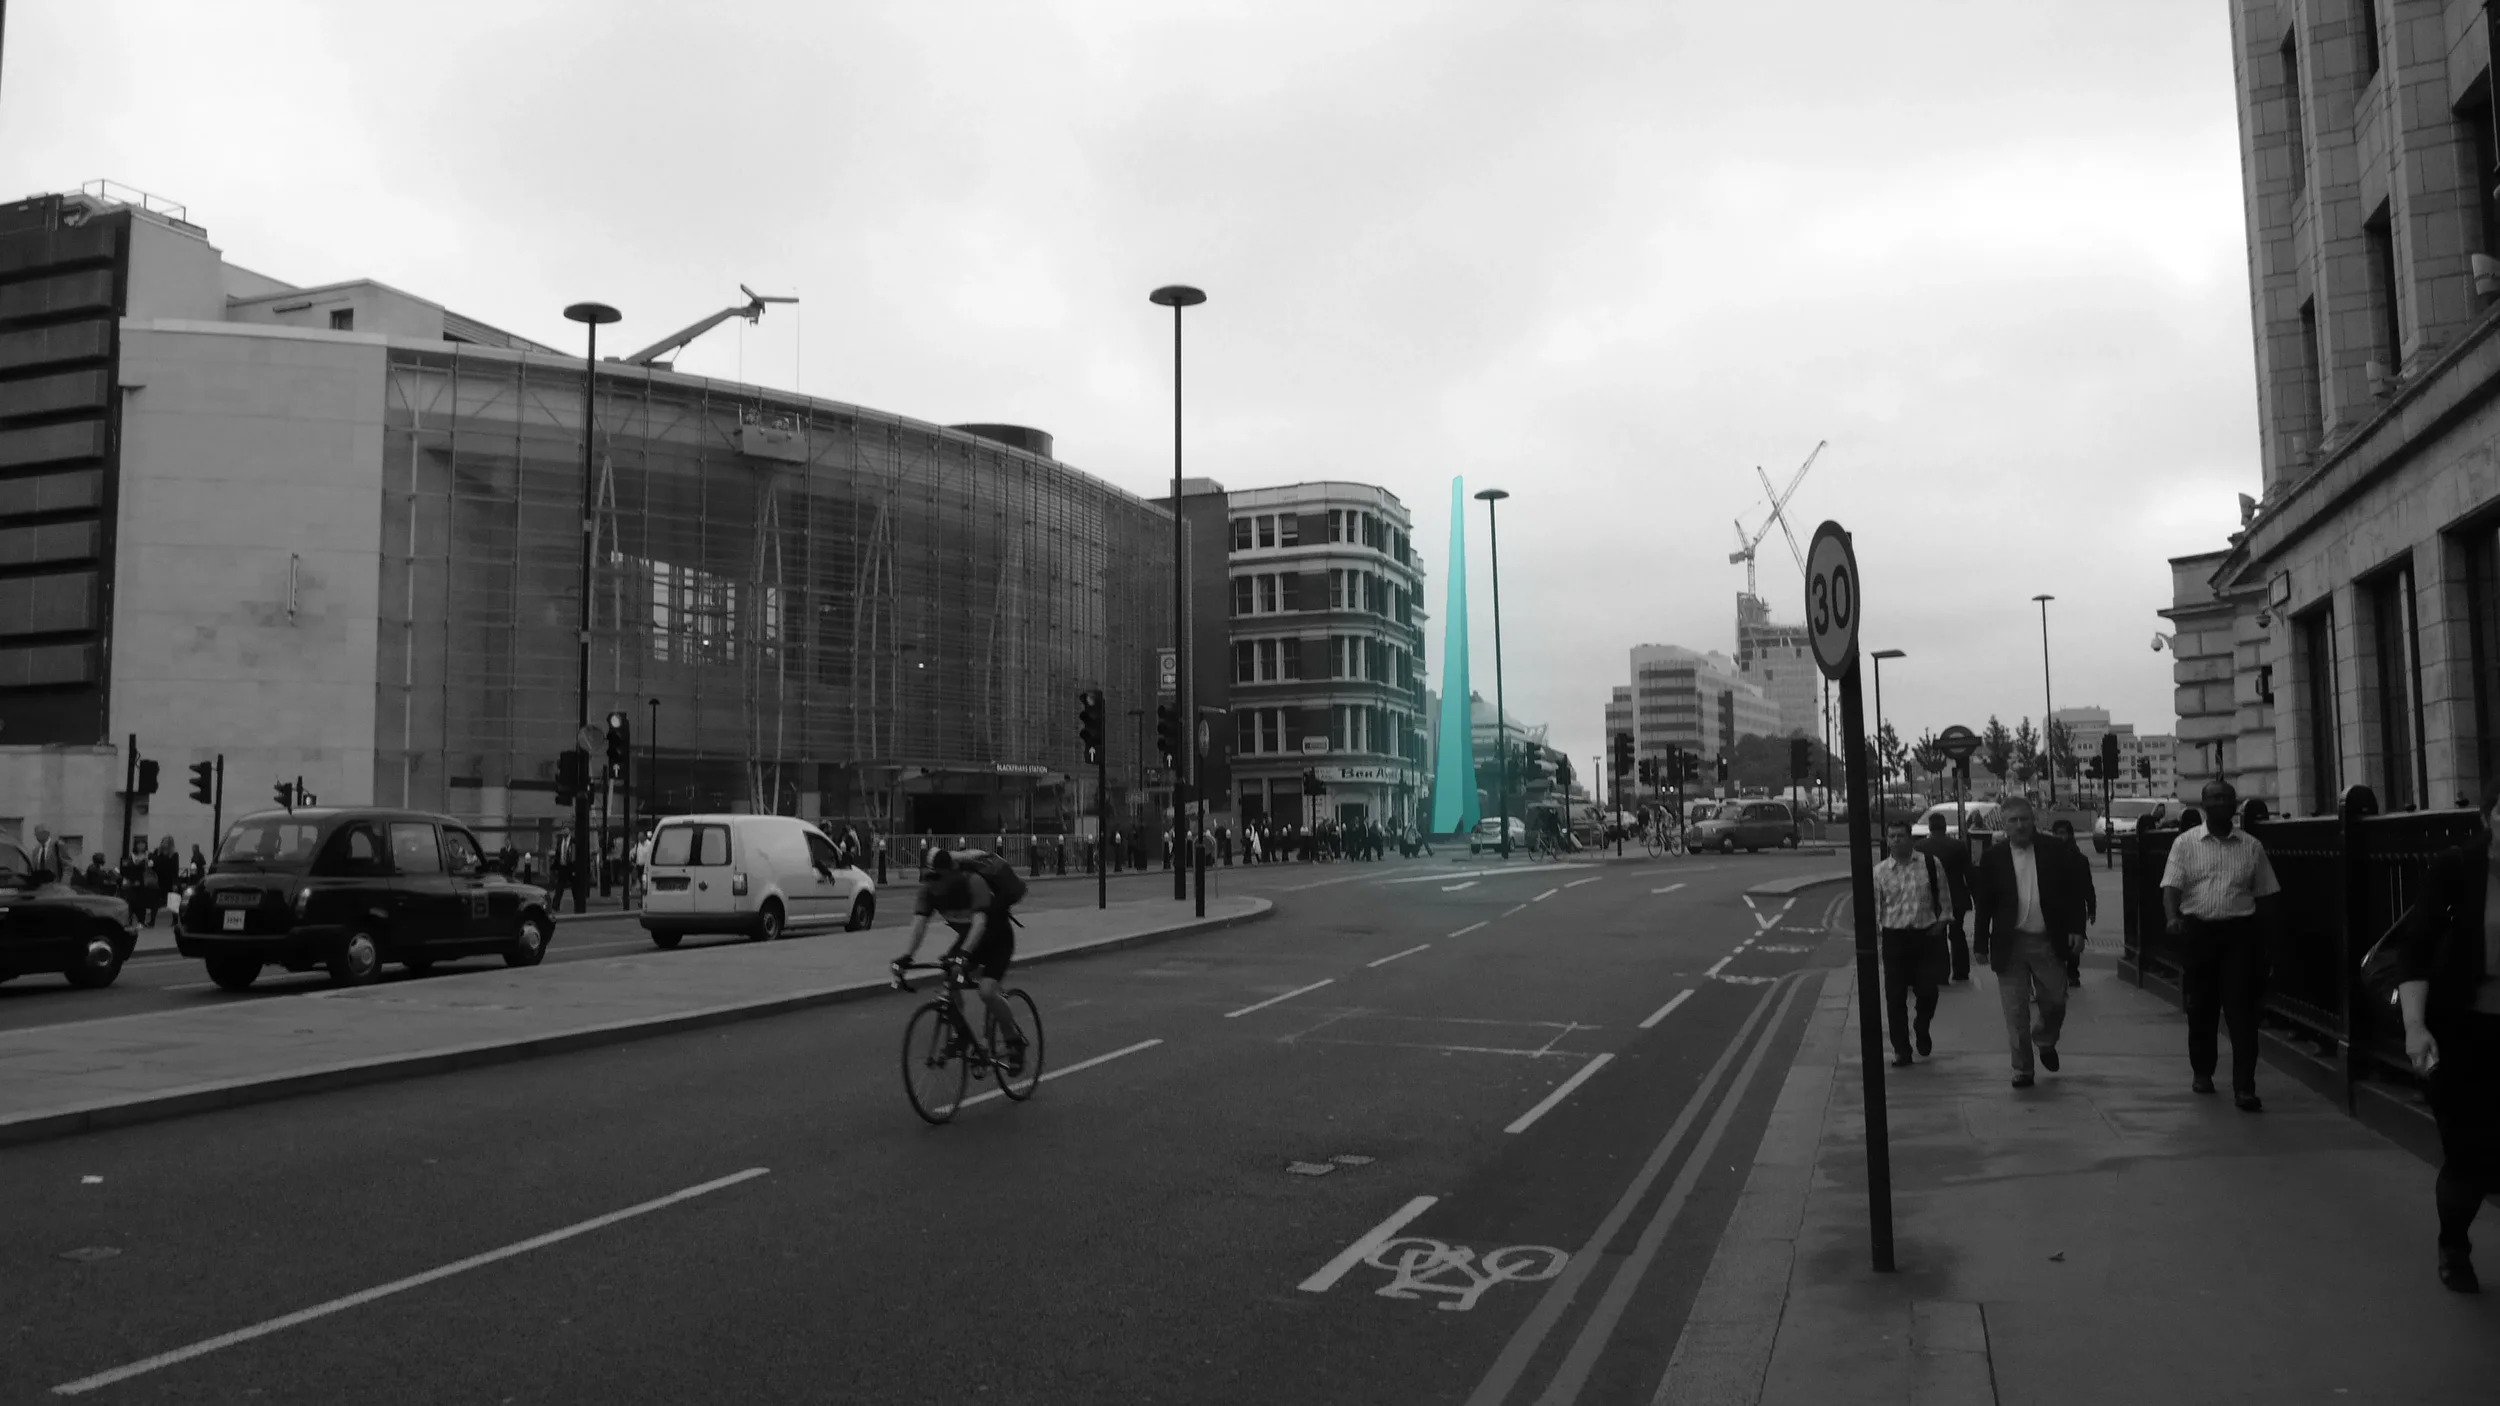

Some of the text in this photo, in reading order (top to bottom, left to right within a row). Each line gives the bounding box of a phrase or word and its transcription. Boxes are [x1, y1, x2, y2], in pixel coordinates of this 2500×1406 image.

[1812, 564, 1850, 636] 30
[996, 763, 1048, 774] BLACKFRIARS STATION
